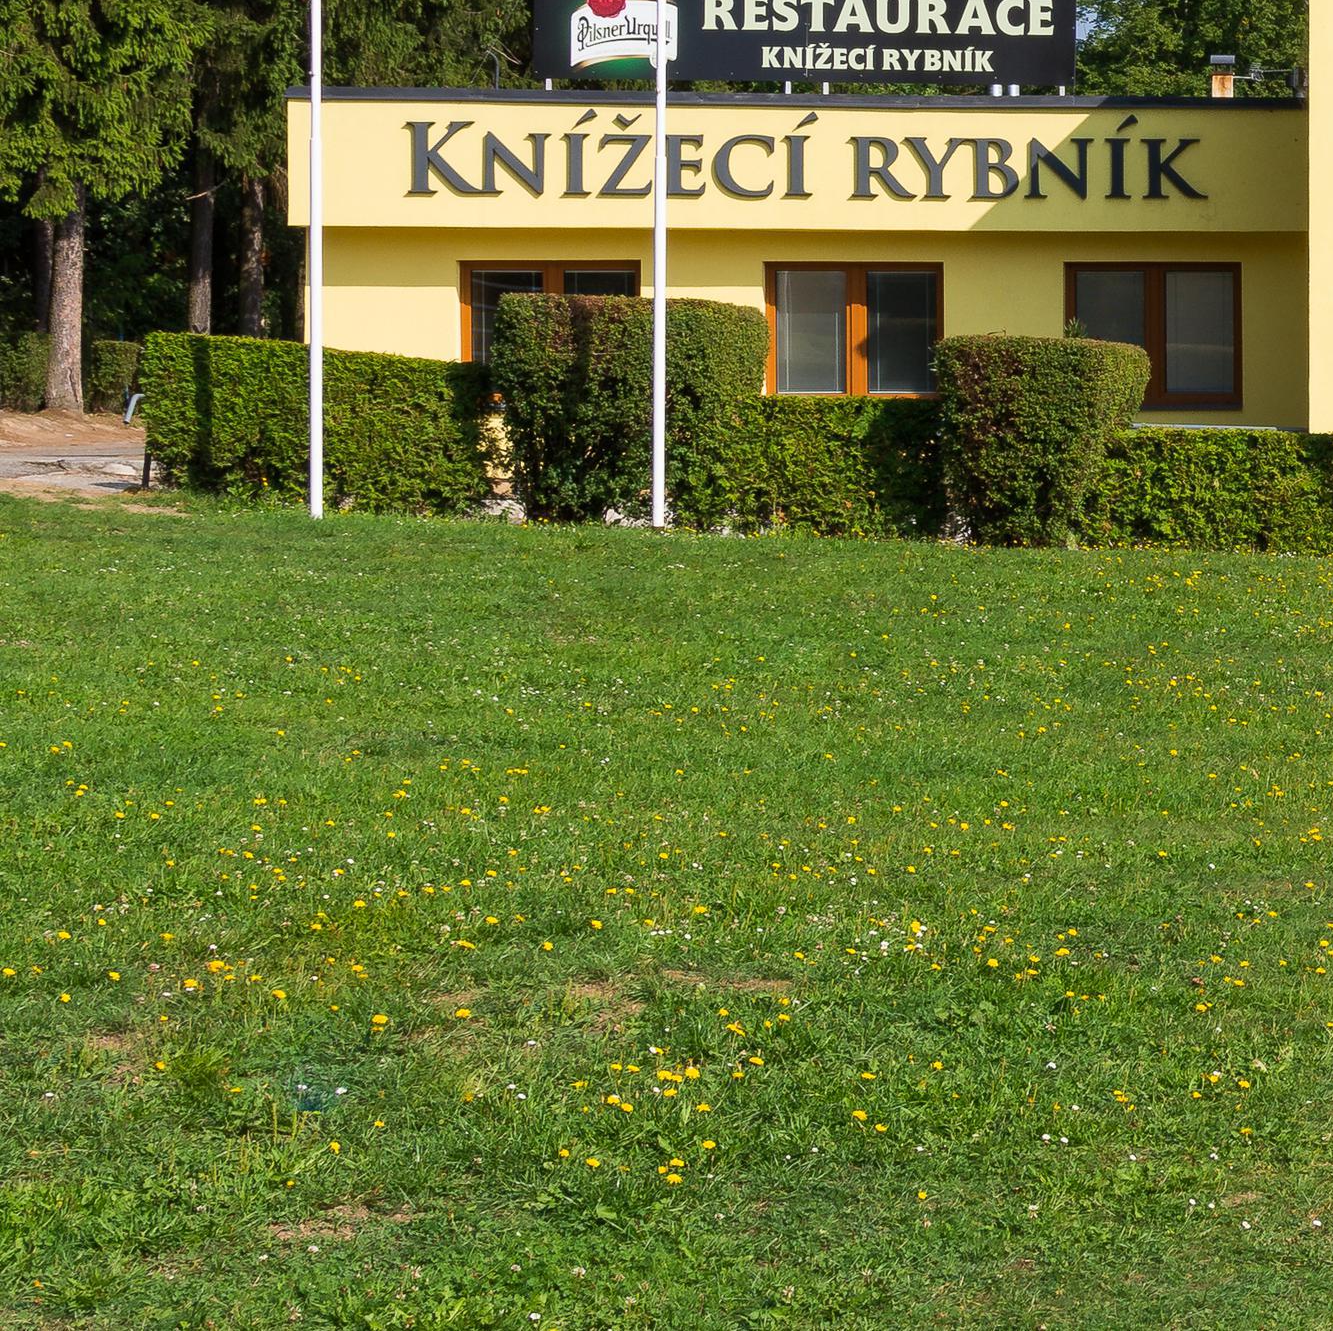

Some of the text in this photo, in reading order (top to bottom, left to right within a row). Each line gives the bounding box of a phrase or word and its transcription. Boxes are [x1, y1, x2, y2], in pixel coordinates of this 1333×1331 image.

[577, 16, 625, 51] Pilsner
[761, 43, 994, 72] KNÍŽECÍ RYBNÍK
[403, 108, 1209, 201] KNÍŽECÍ RYBNÍK
